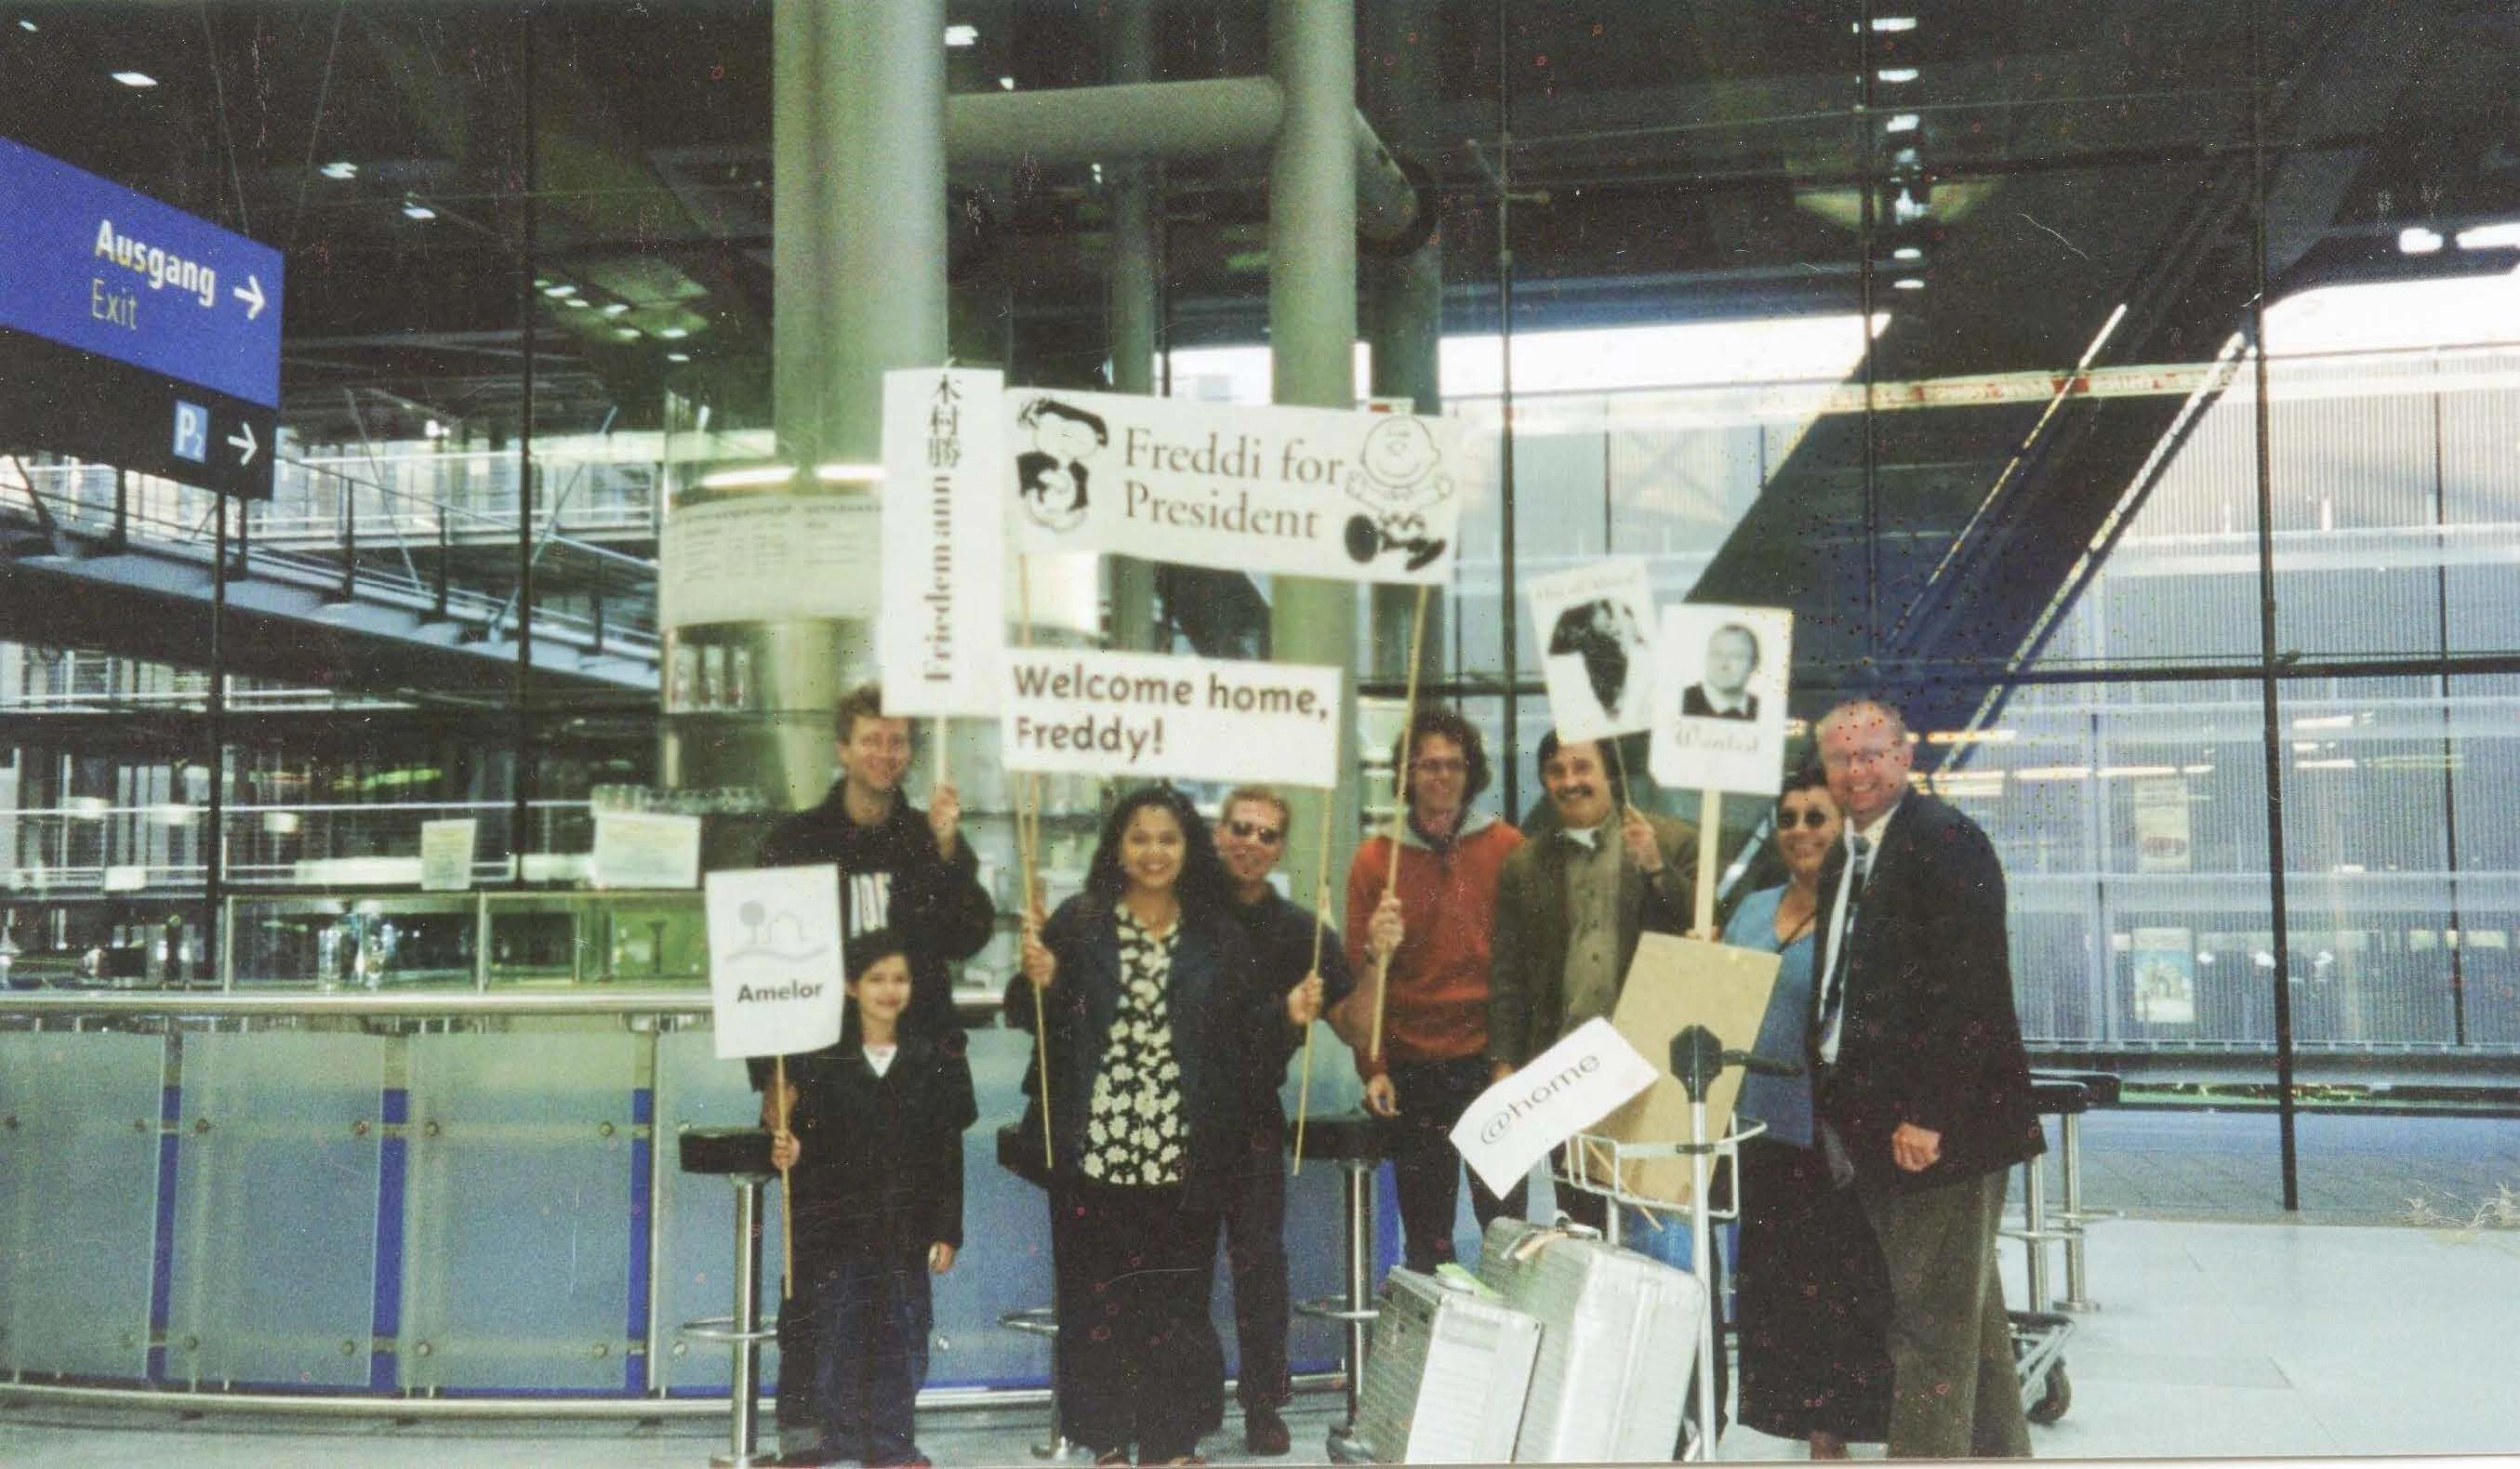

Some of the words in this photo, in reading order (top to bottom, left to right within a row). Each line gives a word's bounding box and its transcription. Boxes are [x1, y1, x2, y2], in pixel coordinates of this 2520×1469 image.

[96, 219, 216, 307] Ausgang
[91, 279, 138, 331] Exit
[1124, 427, 1262, 480] Freddi
[1280, 438, 1345, 484] for
[1123, 482, 1319, 539] President
[924, 475, 952, 681] Friedemann
[1013, 664, 1192, 707] Welcome
[1209, 673, 1329, 721] home,
[1015, 716, 1163, 762] Freddy!
[737, 976, 825, 1003] Amelor
[1480, 1053, 1601, 1146] @home
